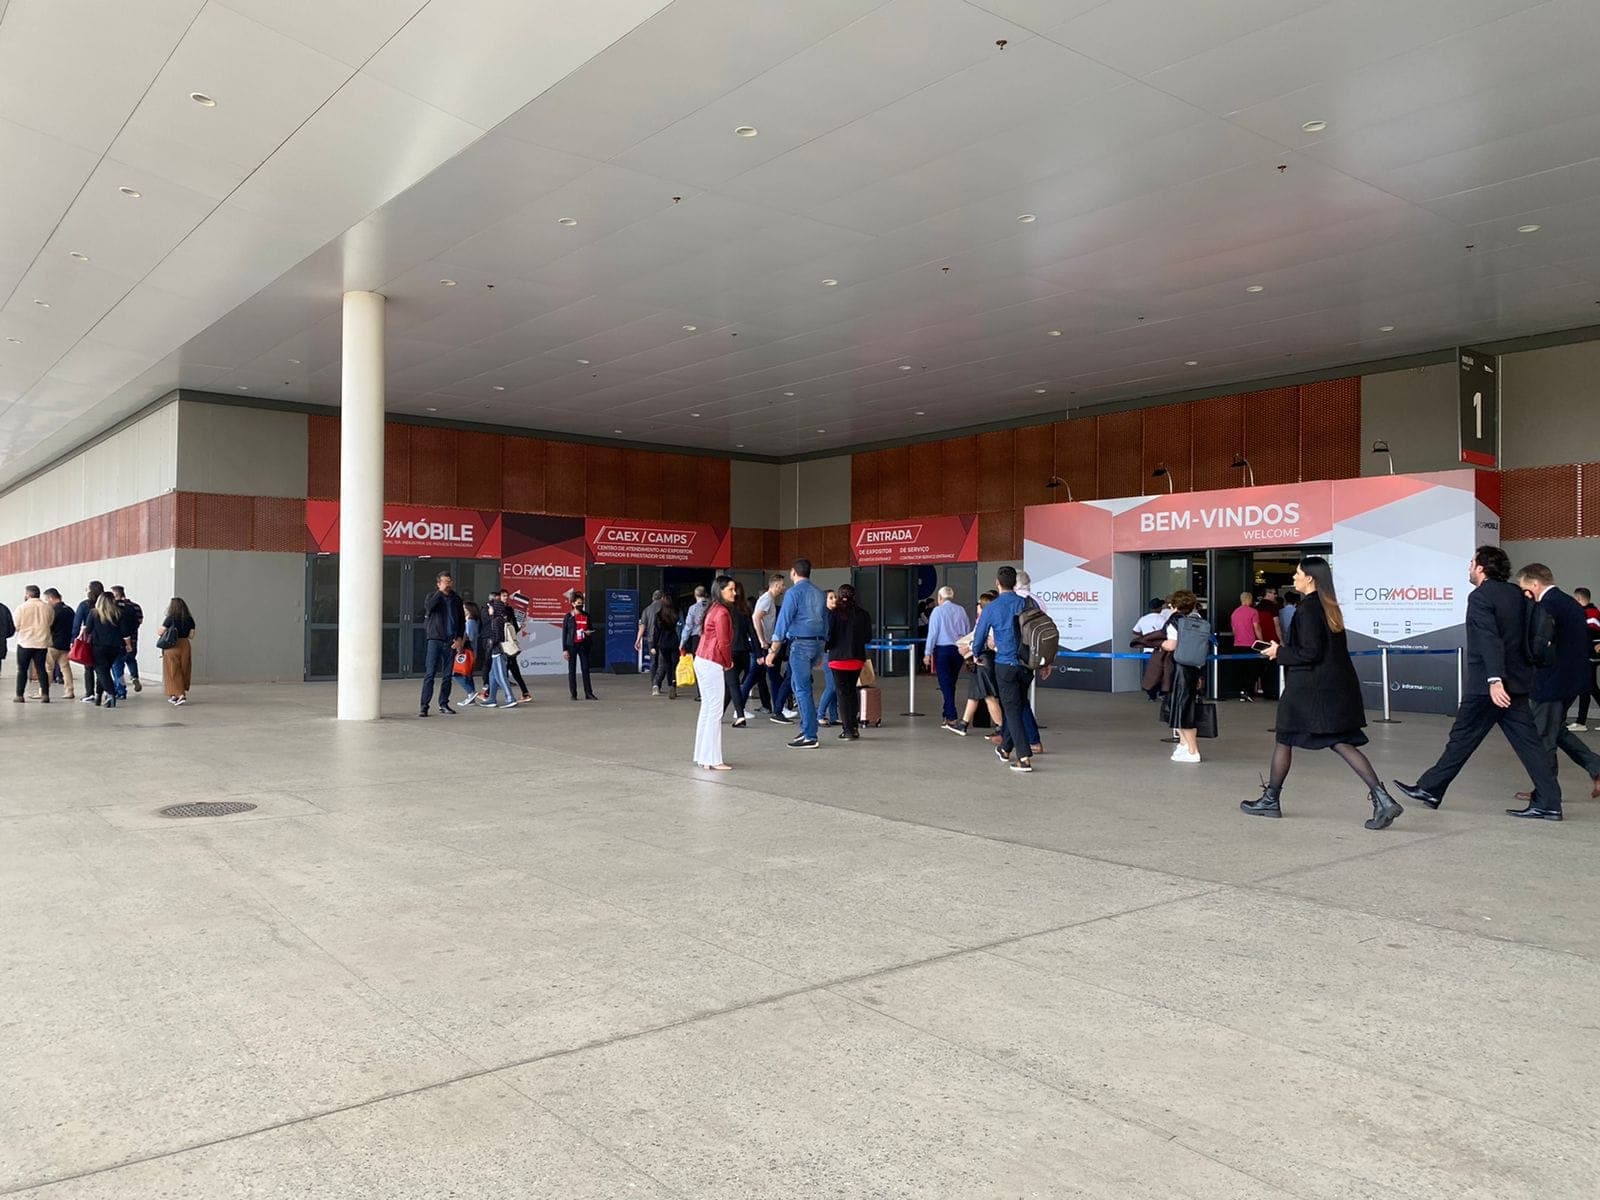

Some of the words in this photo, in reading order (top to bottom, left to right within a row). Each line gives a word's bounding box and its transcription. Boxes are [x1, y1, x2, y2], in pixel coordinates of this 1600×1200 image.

[1473, 391, 1482, 439] 1
[1140, 502, 1300, 533] BEM-VINDOS
[607, 529, 640, 542] CAEX
[647, 532, 688, 545] CAMPS
[866, 529, 913, 543] ENTRADA
[1243, 528, 1300, 540] WELCOME
[625, 546, 660, 554] ATENDIMENTO
[630, 552, 659, 560] PRESTADOR
[866, 547, 892, 555] EXPOSITOR
